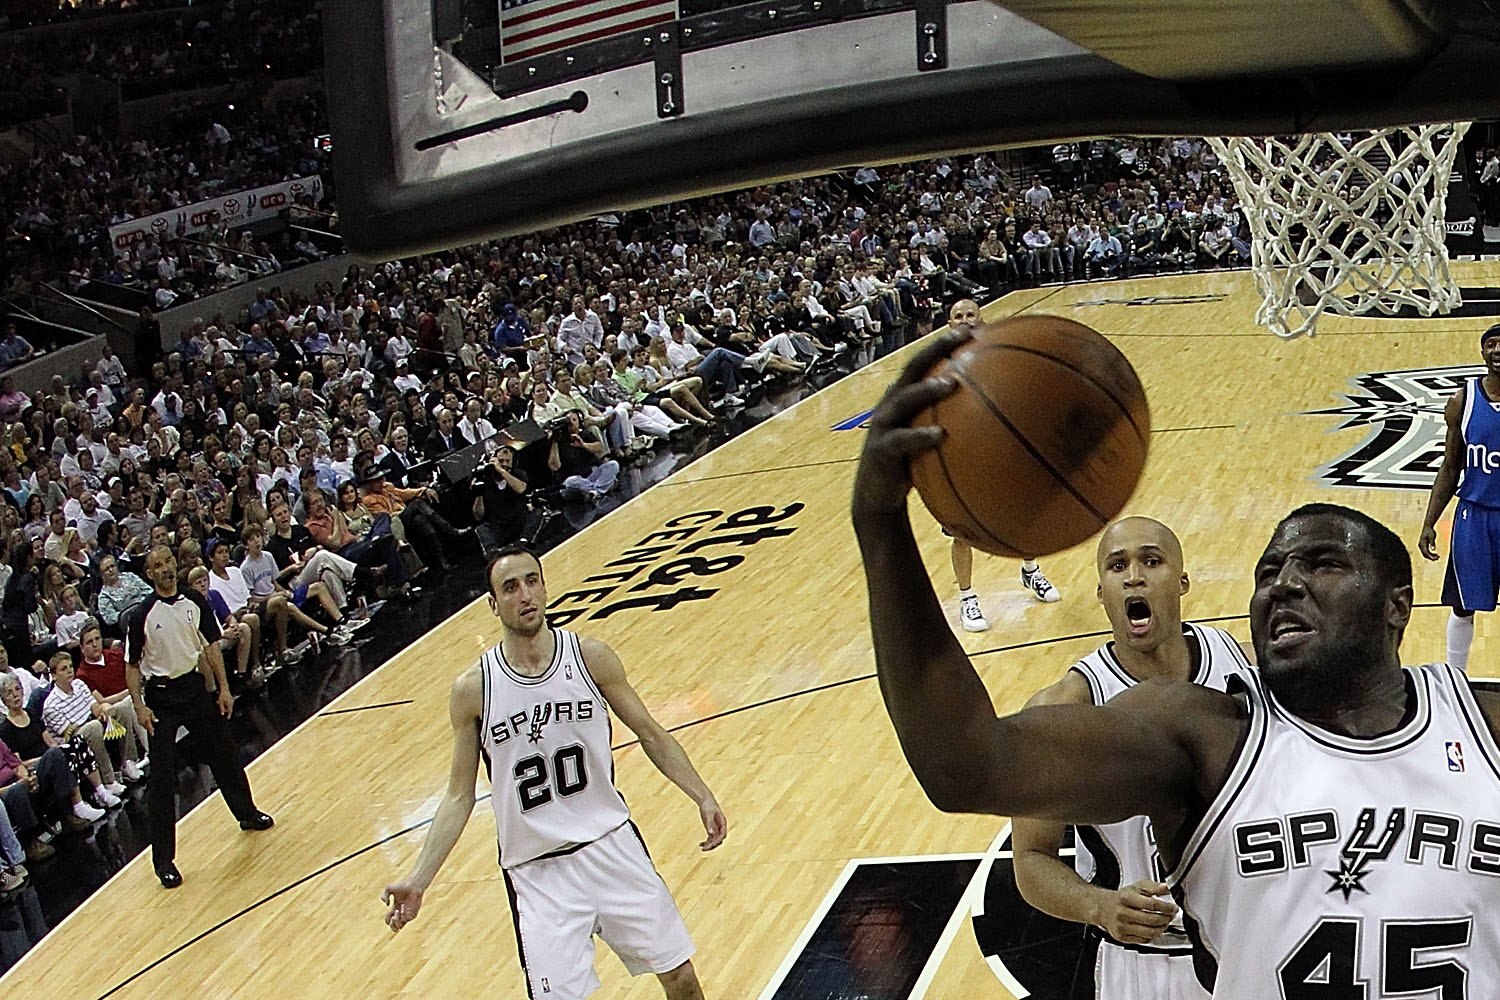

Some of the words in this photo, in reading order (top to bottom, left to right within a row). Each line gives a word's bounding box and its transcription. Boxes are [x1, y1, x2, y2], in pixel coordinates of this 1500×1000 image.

[587, 502, 805, 621] at&t
[490, 699, 593, 745] SPURS
[512, 742, 591, 814] 20
